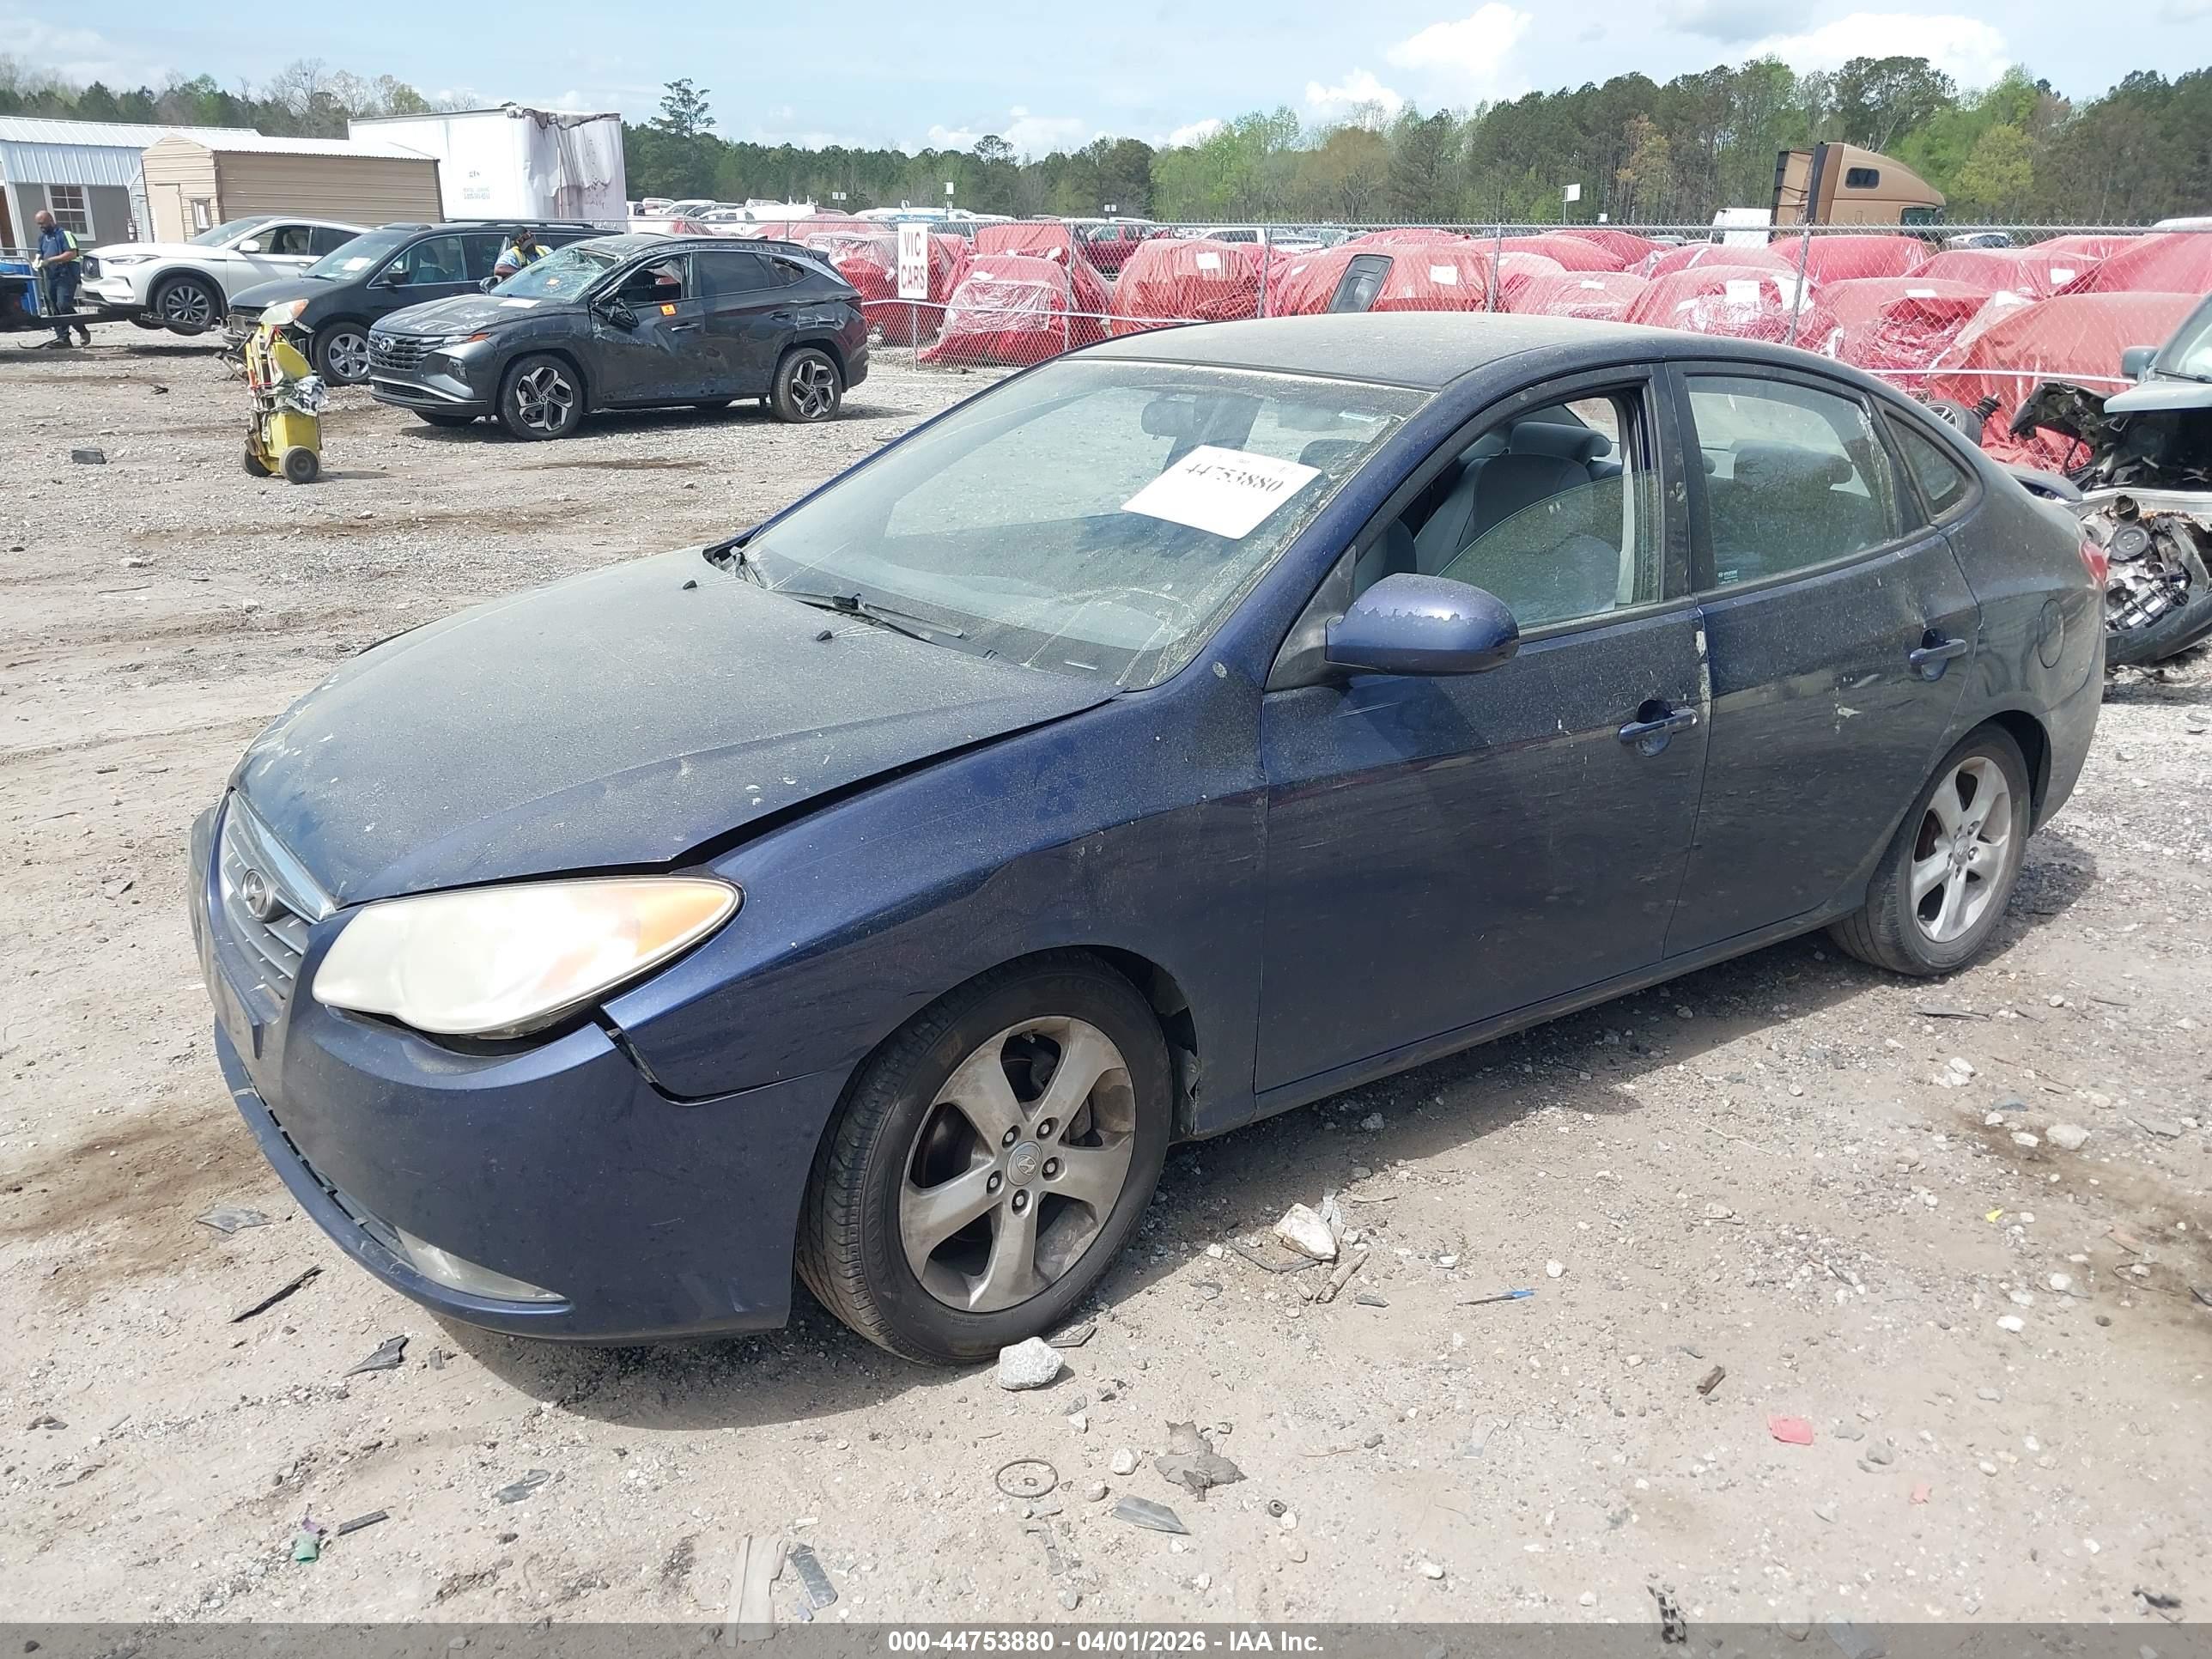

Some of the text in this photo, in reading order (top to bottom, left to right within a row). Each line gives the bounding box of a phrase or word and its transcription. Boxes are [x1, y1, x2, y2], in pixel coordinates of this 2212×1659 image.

[903, 231, 921, 257] VIC
[901, 264, 926, 290] CARS
[1185, 463, 1285, 493] 44753880
